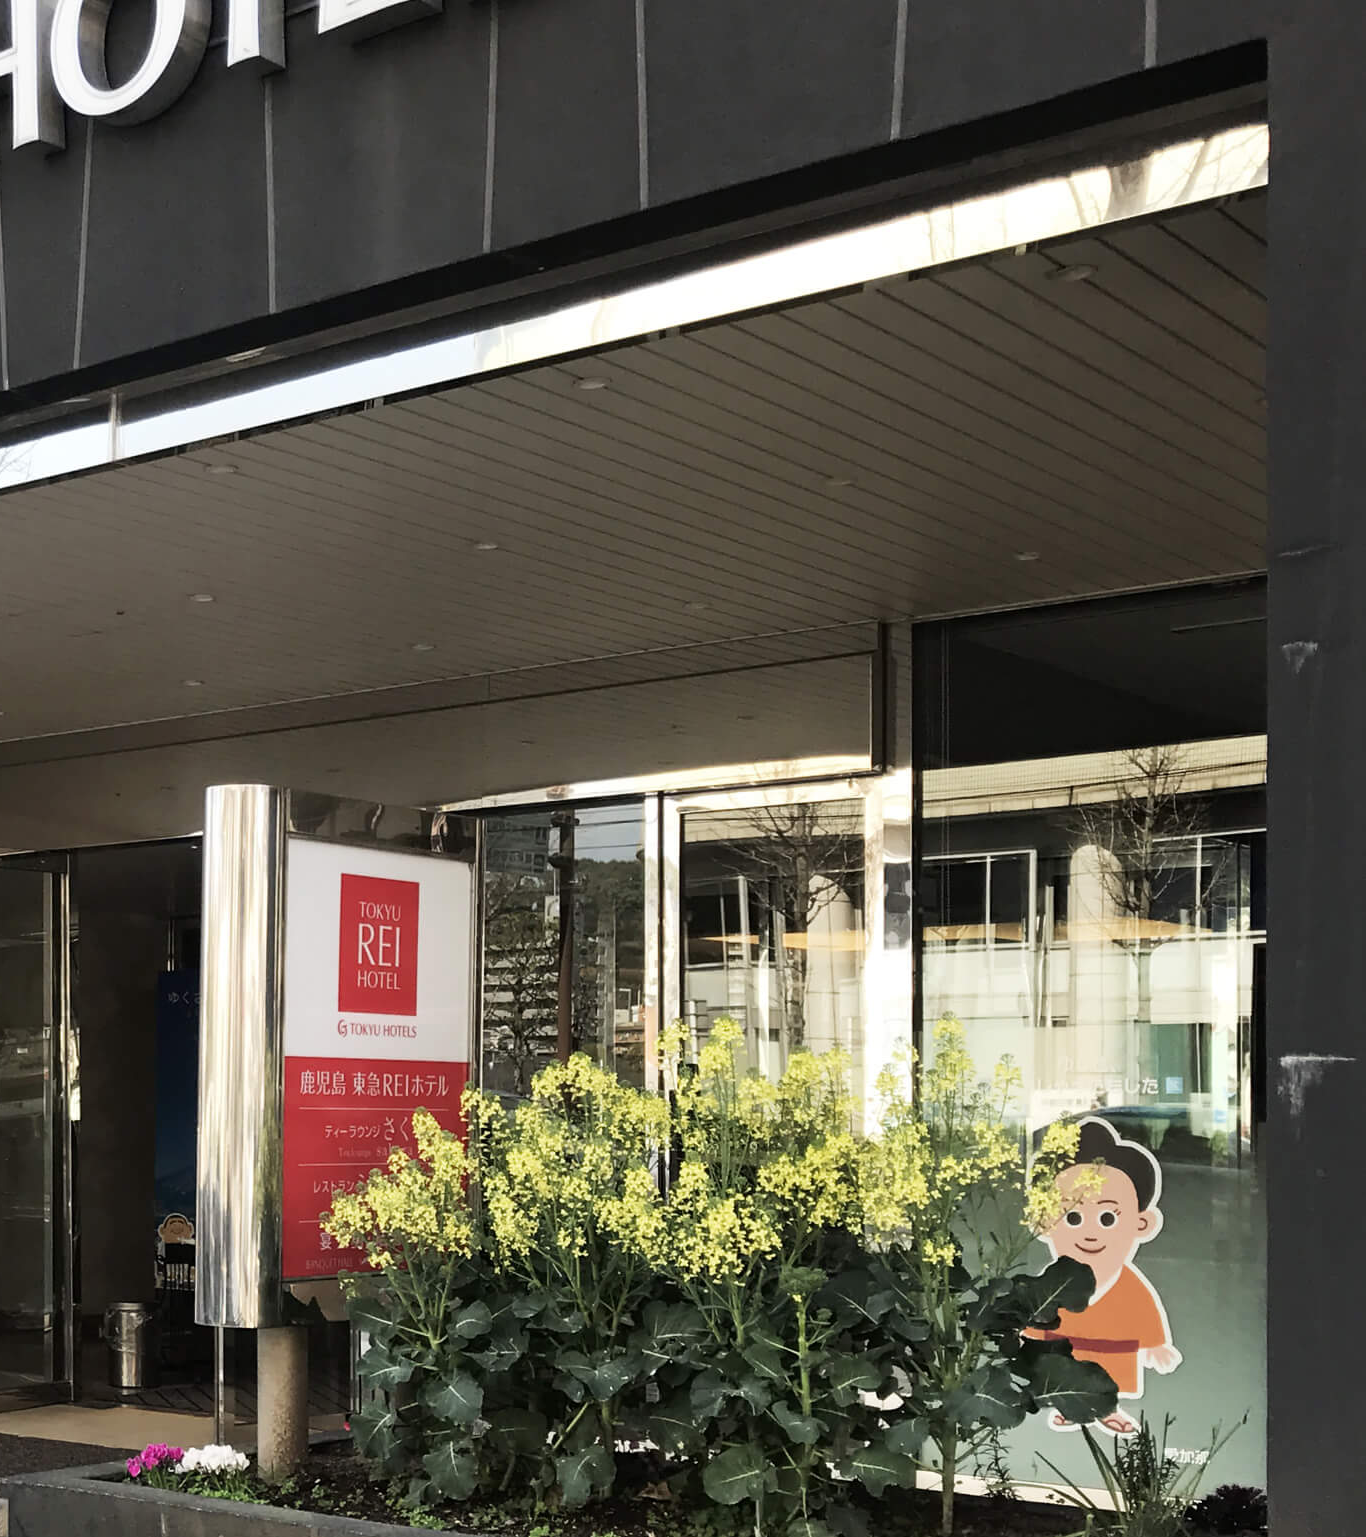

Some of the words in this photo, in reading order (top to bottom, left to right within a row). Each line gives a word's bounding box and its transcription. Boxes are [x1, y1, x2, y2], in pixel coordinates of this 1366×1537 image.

[358, 901, 402, 922] TOKYU
[357, 923, 401, 968] REI
[356, 970, 402, 990] HOTEL
[350, 1022, 382, 1037] TOKYU
[383, 1025, 418, 1039] HOTELS
[300, 1070, 347, 1096] 鹿児島
[352, 1071, 449, 1097] 東急REIホテル
[324, 1124, 381, 1139] ティーラウンジ
[383, 1115, 409, 1142] さく
